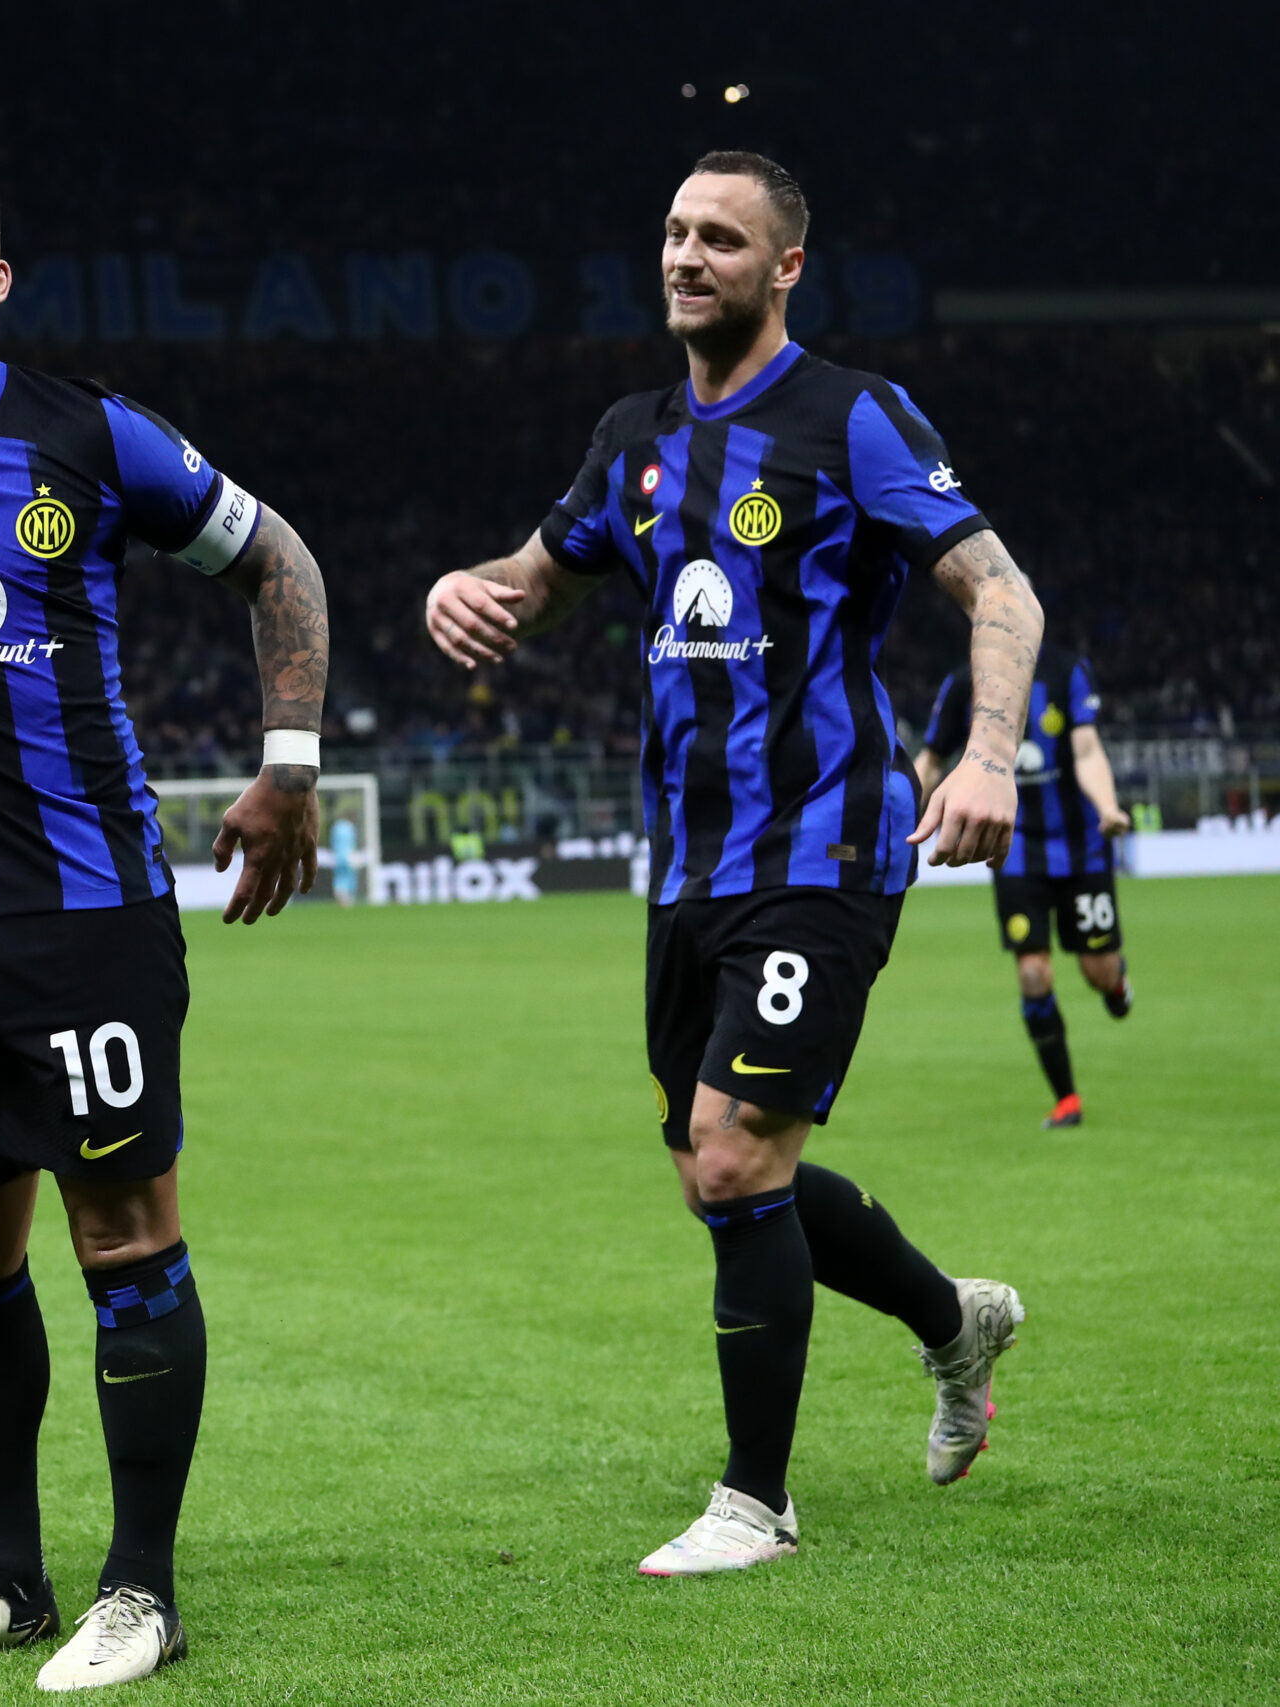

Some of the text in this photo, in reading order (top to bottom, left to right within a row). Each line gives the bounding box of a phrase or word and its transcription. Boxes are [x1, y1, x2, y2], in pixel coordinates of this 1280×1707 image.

[375, 855, 543, 905] nilox
[756, 949, 810, 1026] 8
[49, 1020, 145, 1117] 10
